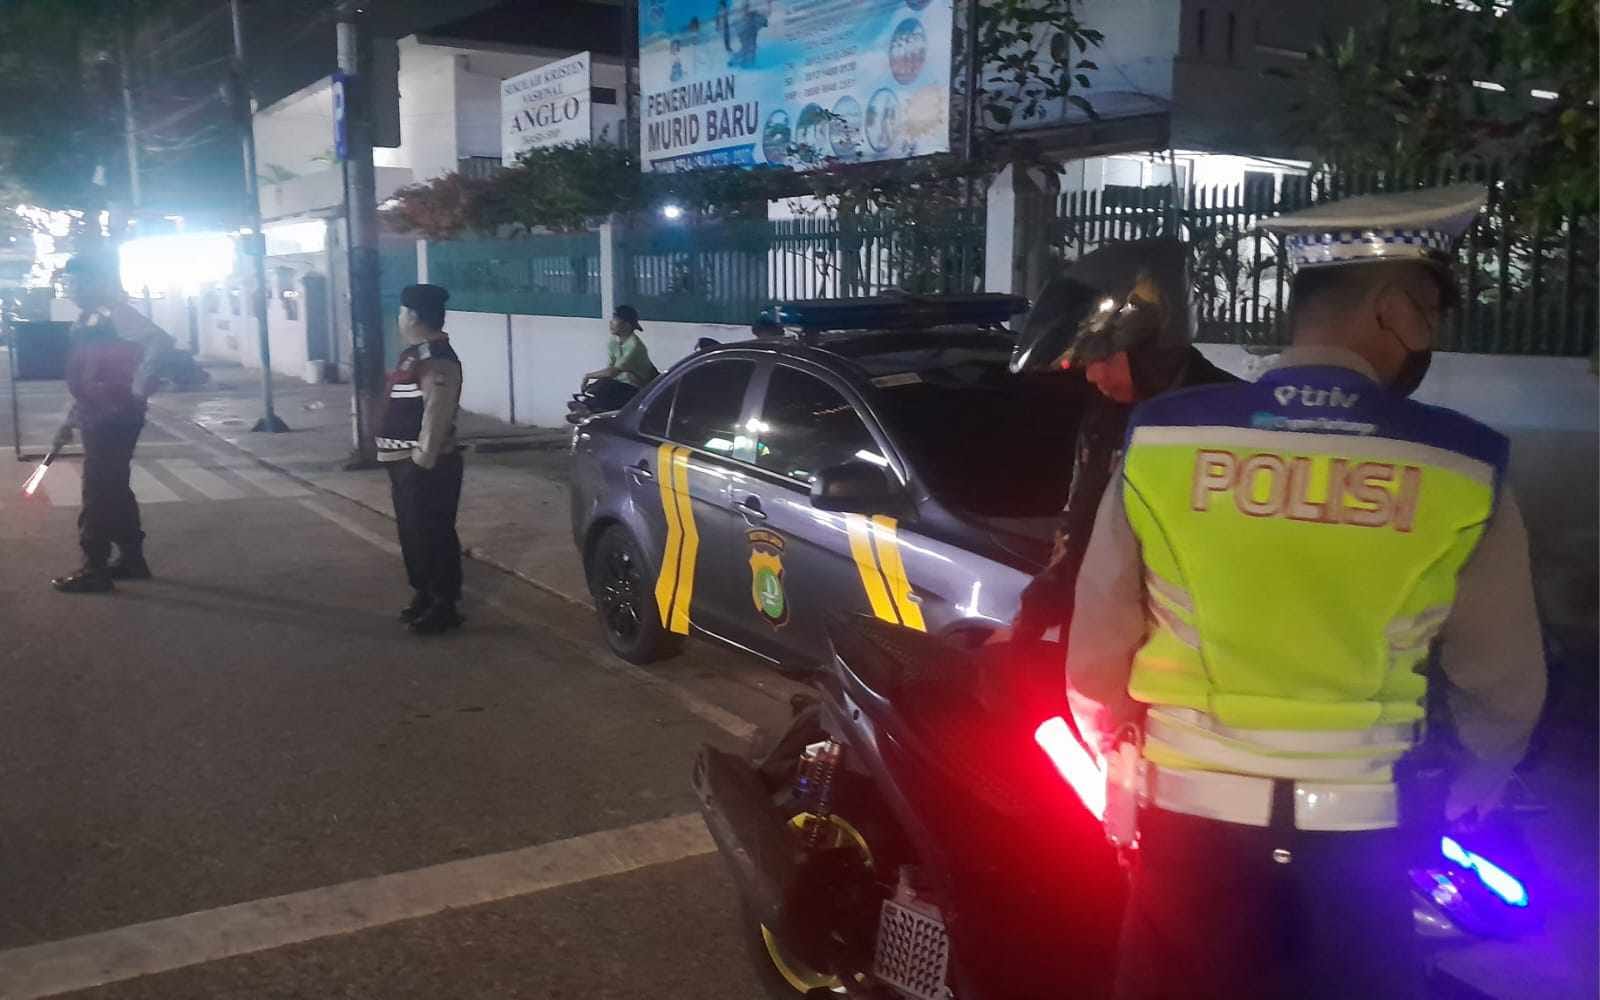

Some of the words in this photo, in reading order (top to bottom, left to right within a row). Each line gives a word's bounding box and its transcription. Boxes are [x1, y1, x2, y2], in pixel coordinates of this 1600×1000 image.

[510, 96, 580, 134] ANGLO
[647, 73, 736, 118] PENERIMAAN
[647, 113, 700, 153] MURID
[706, 101, 760, 142] BARU
[1191, 448, 1422, 534] POLISI
